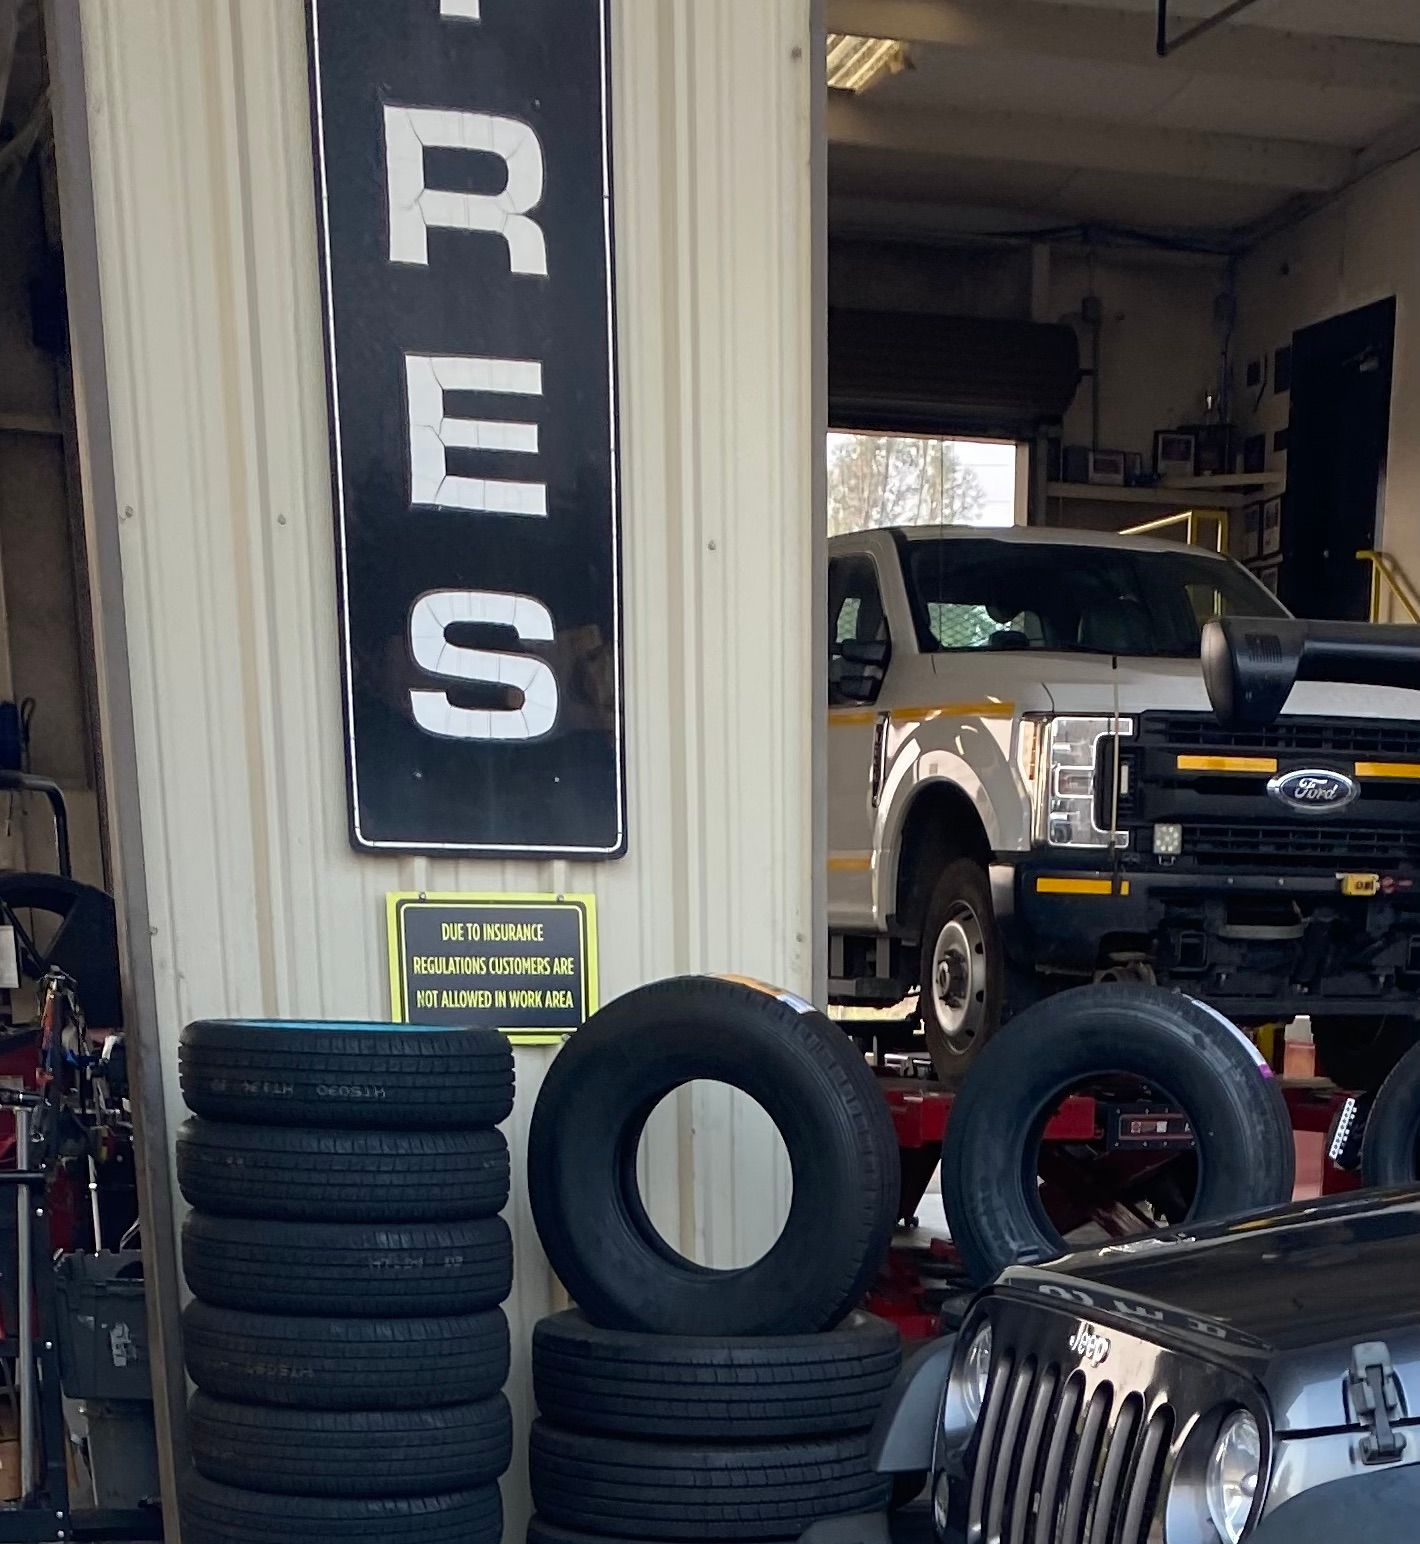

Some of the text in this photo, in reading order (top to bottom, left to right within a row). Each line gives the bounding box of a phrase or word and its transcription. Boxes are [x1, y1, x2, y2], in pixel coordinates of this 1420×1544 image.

[384, 0, 558, 740] RES
[1294, 777, 1338, 800] Ford
[441, 922, 544, 942] DUE TO INSURANCE
[413, 956, 575, 975] REGULATIONS CUSTOMERS ARE
[416, 989, 574, 1009] NOT ALLOWED IN WORK AREA
[1068, 1320, 1111, 1368] Jeep
